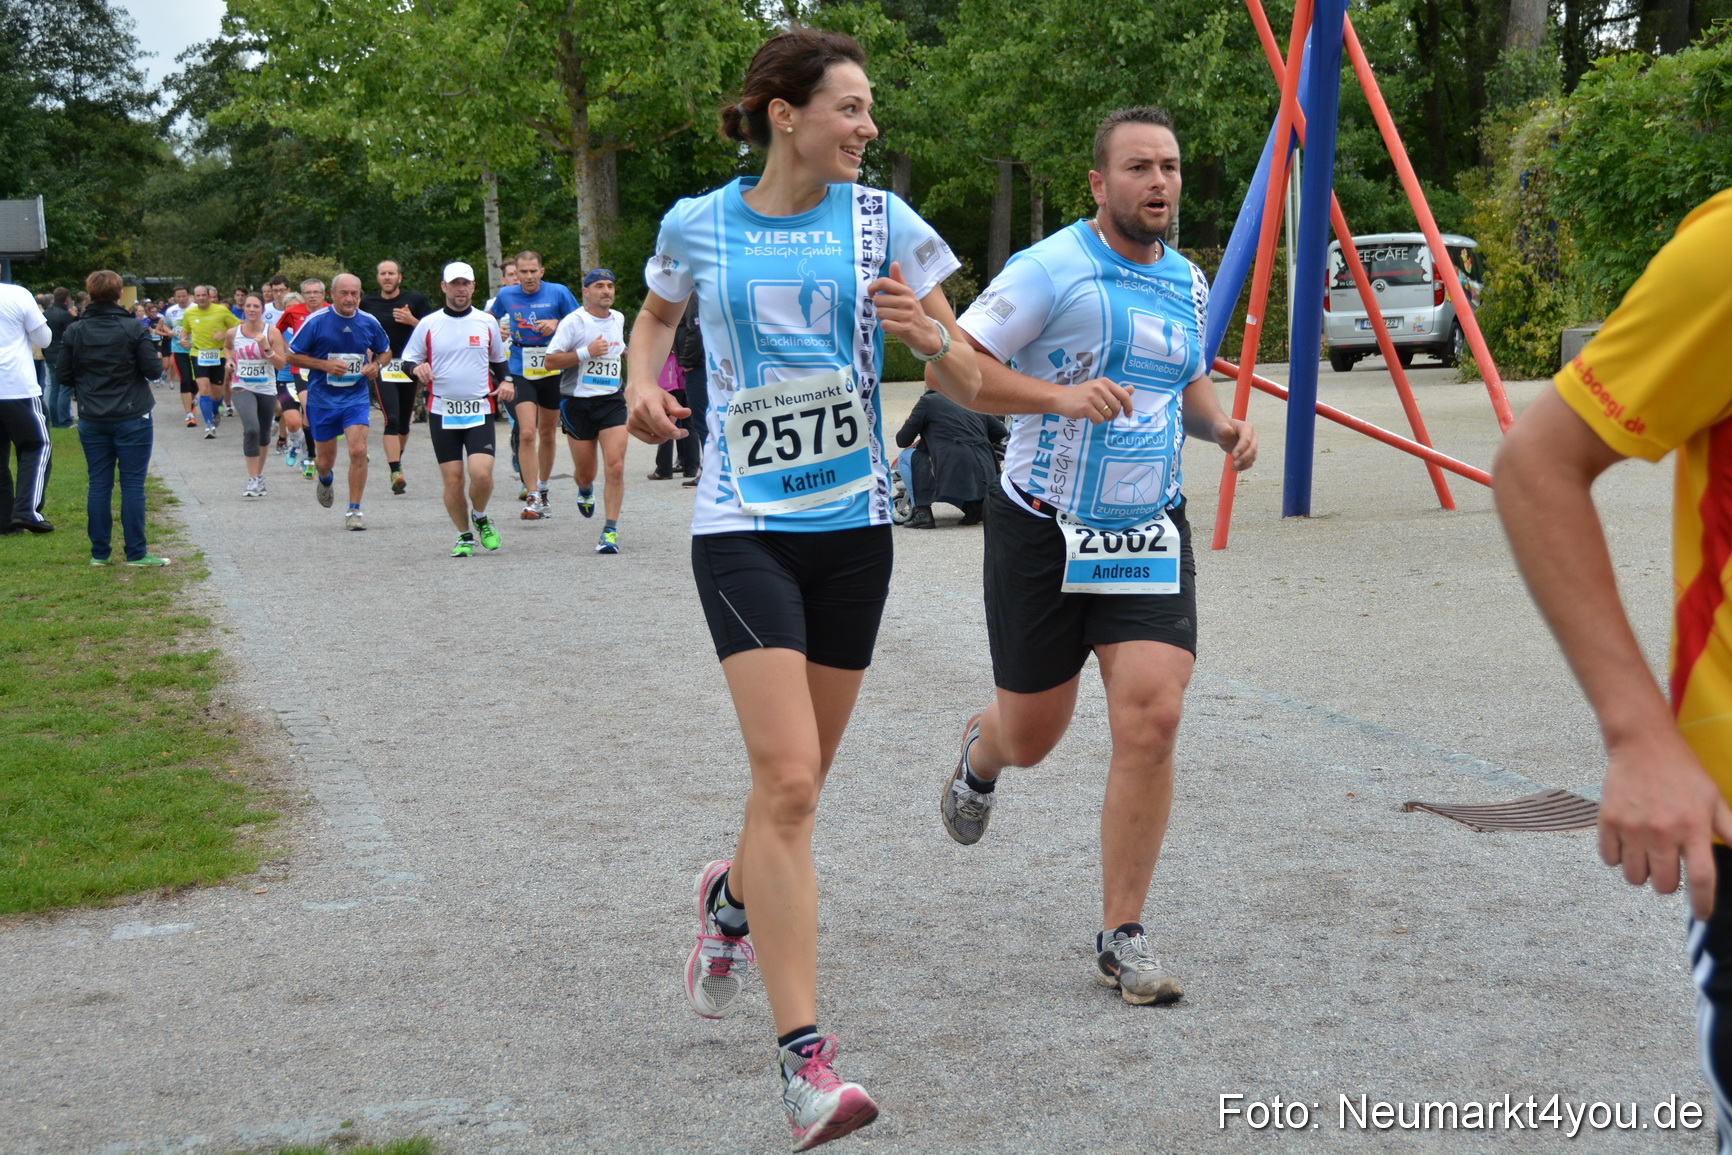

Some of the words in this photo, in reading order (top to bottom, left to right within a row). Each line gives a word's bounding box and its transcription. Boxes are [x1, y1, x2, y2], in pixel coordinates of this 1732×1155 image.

[744, 231, 841, 244] VIERTL
[744, 246, 799, 259] DESIGN
[801, 244, 843, 258] GmbH
[861, 219, 873, 281] VIERTL
[1116, 279, 1157, 295] DESIGN
[760, 336, 832, 348] slacklinebox
[240, 365, 266, 376] 2054
[587, 360, 618, 377] 2313
[1128, 358, 1181, 376] slacklinebox
[446, 401, 480, 415] 3030
[727, 398, 772, 417] PARTL
[774, 386, 842, 408] Neumarkt
[742, 401, 859, 468] 2575
[1027, 413, 1060, 495] VIERT
[781, 467, 837, 494] Katrin
[1048, 444, 1074, 505] DESIGN
[1096, 505, 1157, 517] zurrgurtbox
[1092, 564, 1150, 579] Andreas
